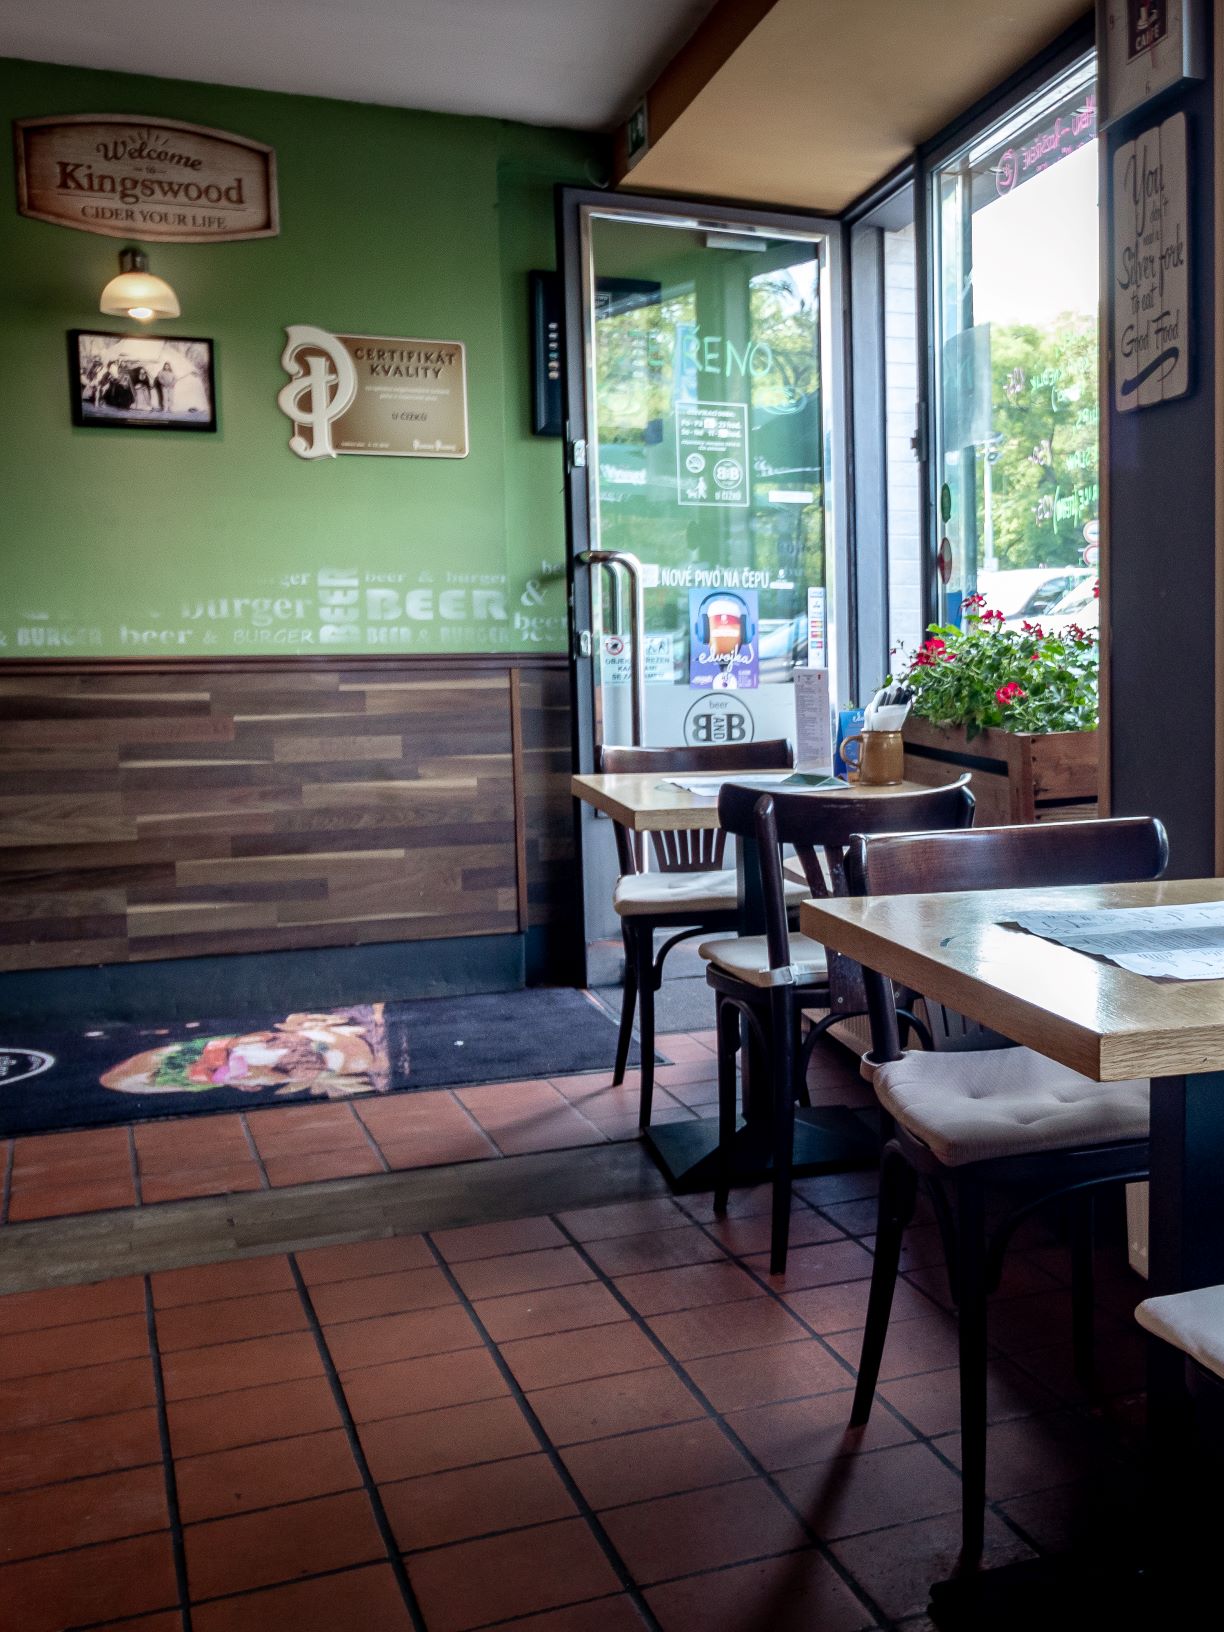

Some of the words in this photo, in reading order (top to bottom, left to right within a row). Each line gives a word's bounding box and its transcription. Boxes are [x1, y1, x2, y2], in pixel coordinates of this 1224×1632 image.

[96, 141, 203, 171] Welcome
[56, 161, 246, 205] Kingswood
[1123, 145, 1165, 237] You
[81, 205, 136, 223] CIDER
[139, 209, 187, 227] YOUR
[191, 215, 228, 230] LIFE
[1117, 243, 1156, 290] Silver
[1159, 224, 1184, 297] fork
[1121, 320, 1149, 357] Good
[1152, 309, 1180, 349] Food
[370, 365, 443, 380] KVALITY
[661, 566, 692, 587] NOVÉ
[694, 569, 720, 588] PIVO
[723, 569, 740, 588] NA
[742, 567, 769, 588] ČEPU
[366, 588, 508, 621] BEER
[119, 625, 194, 645] beer
[233, 628, 315, 645] BURGER
[366, 627, 413, 644] BEER
[709, 700, 728, 709] beer
[713, 717, 725, 740] AND
